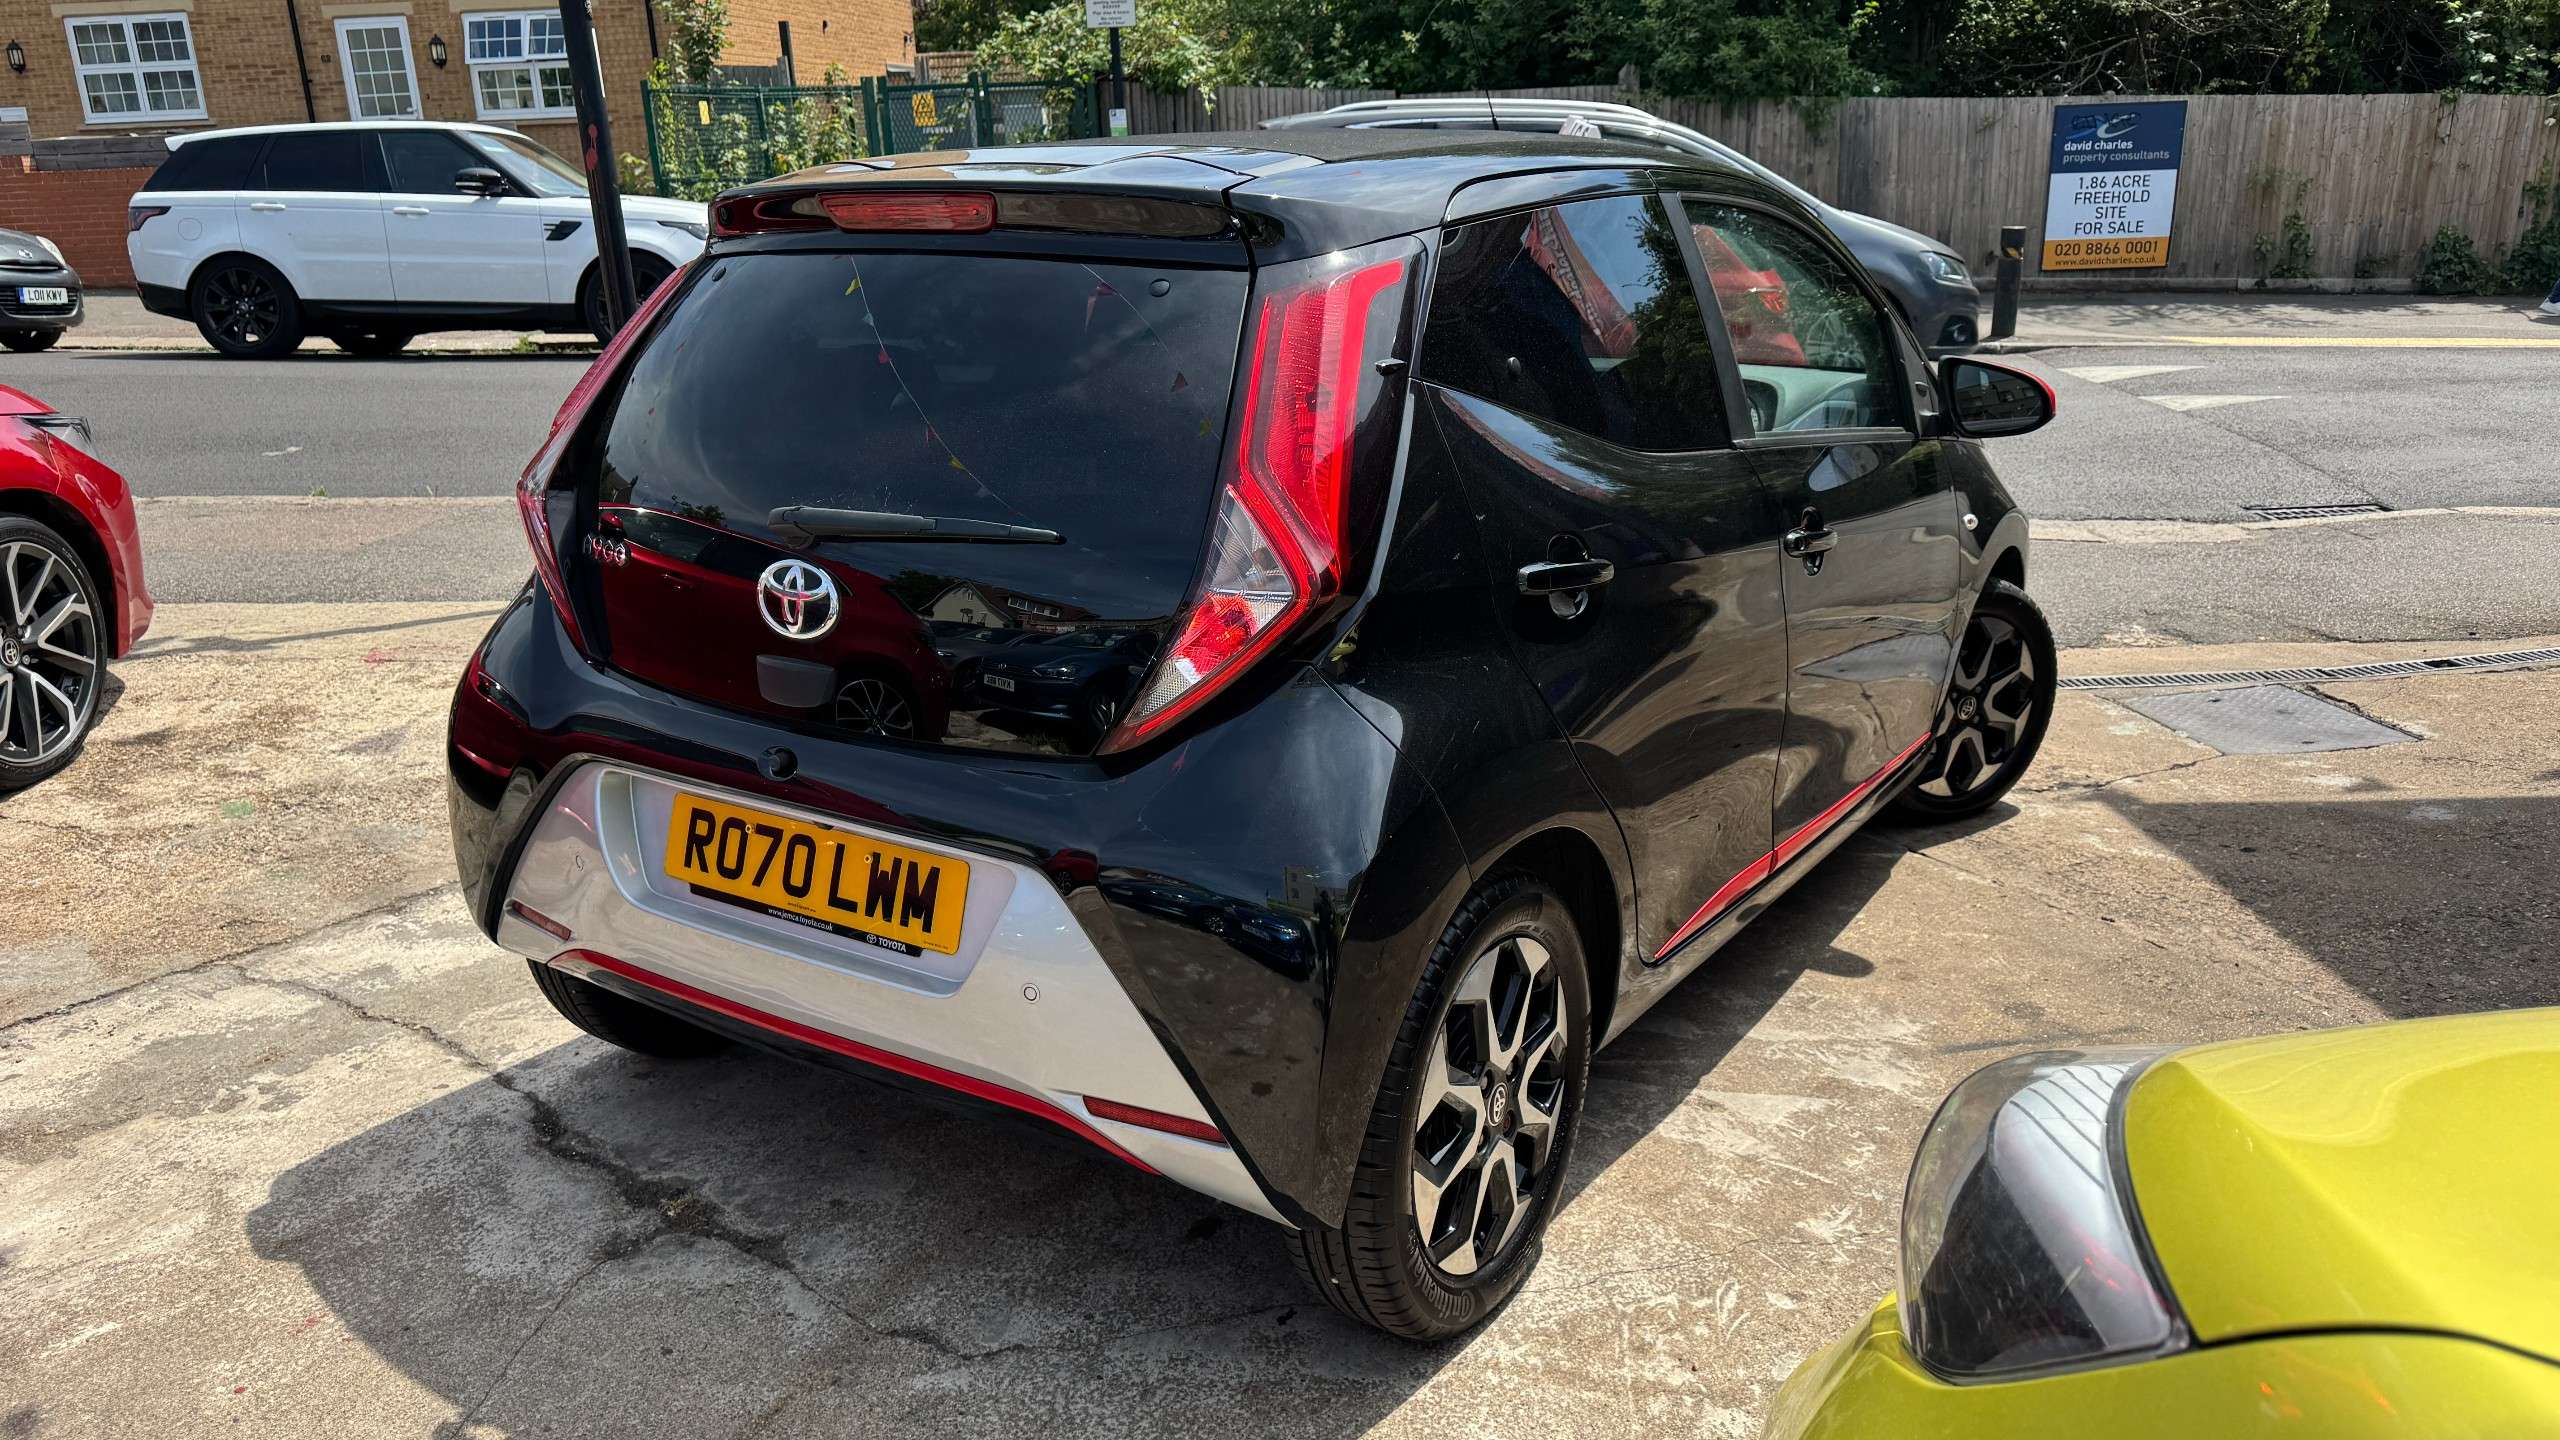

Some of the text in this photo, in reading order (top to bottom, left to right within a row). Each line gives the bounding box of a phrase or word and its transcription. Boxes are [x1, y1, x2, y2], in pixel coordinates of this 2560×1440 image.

[2064, 139, 2133, 151] david charles
[2062, 150, 2170, 165] property consultants
[2079, 174, 2151, 190] 1.86 ACRE
[2074, 190, 2151, 205] FREEHOLD
[2095, 206, 2127, 219] SITE
[2074, 220, 2144, 235] FOR SALE
[2055, 241, 2158, 257] 020 8866 0001
[2055, 256, 2157, 267] www.davidcharles.co.uk
[46, 289, 63, 301] KWY
[684, 807, 941, 934] RO70 LWM
[878, 937, 908, 953] TOYOTA
